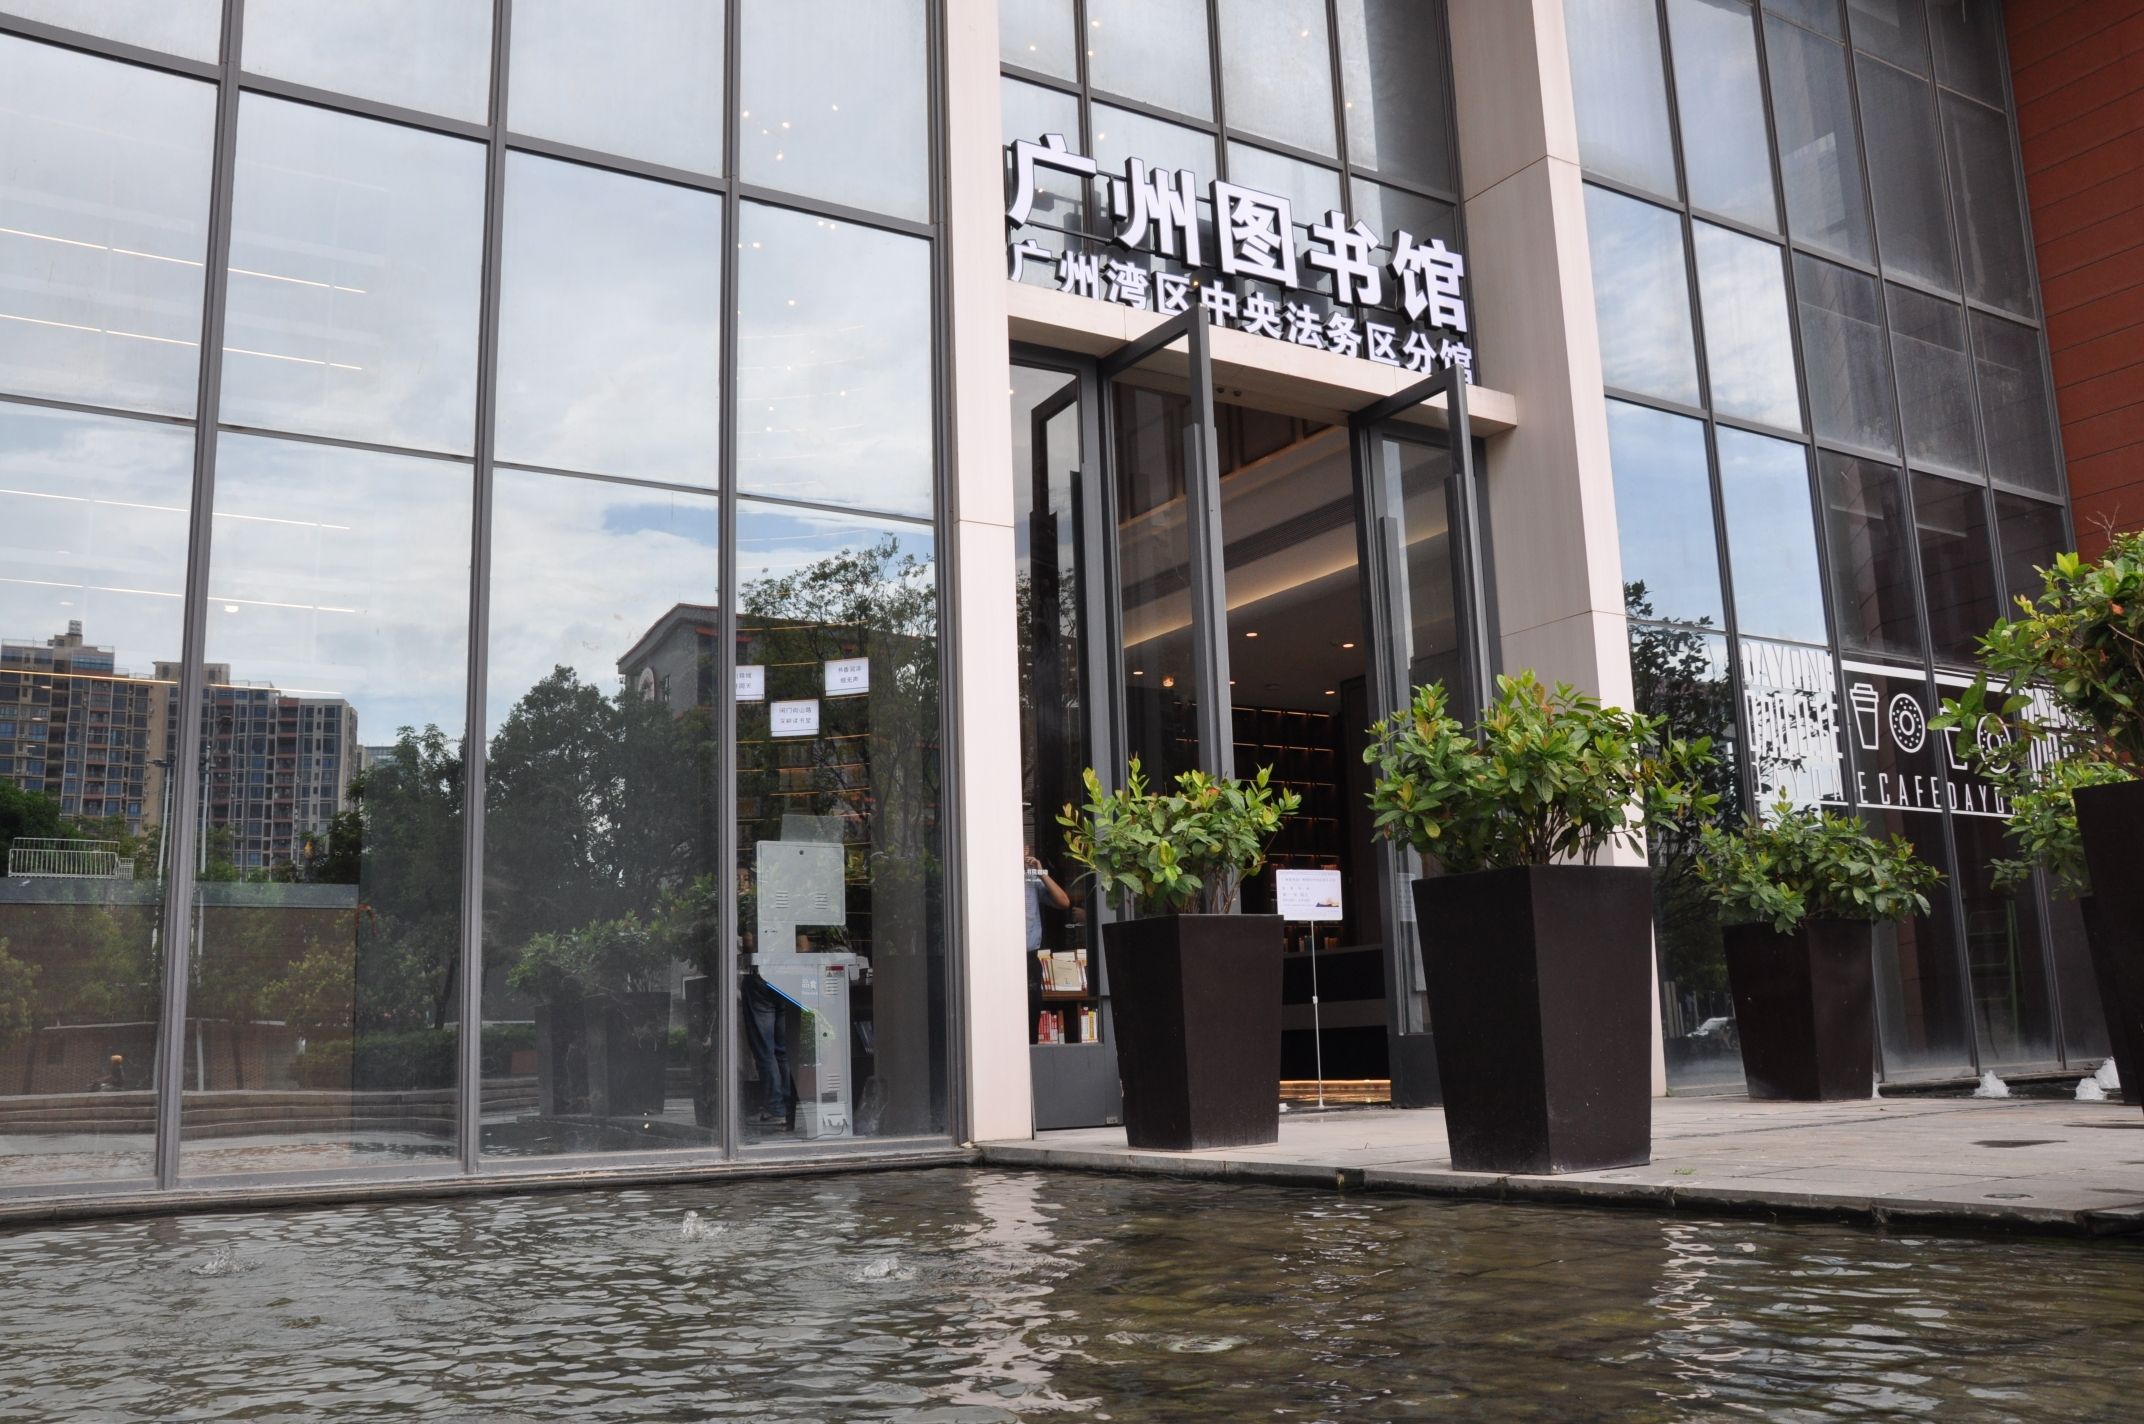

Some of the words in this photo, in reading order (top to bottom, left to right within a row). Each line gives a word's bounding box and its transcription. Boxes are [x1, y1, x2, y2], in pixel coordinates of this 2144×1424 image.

[1007, 134, 1467, 333] 广州图书馆
[1010, 239, 1473, 385] 广州湾区中央法务区分馆
